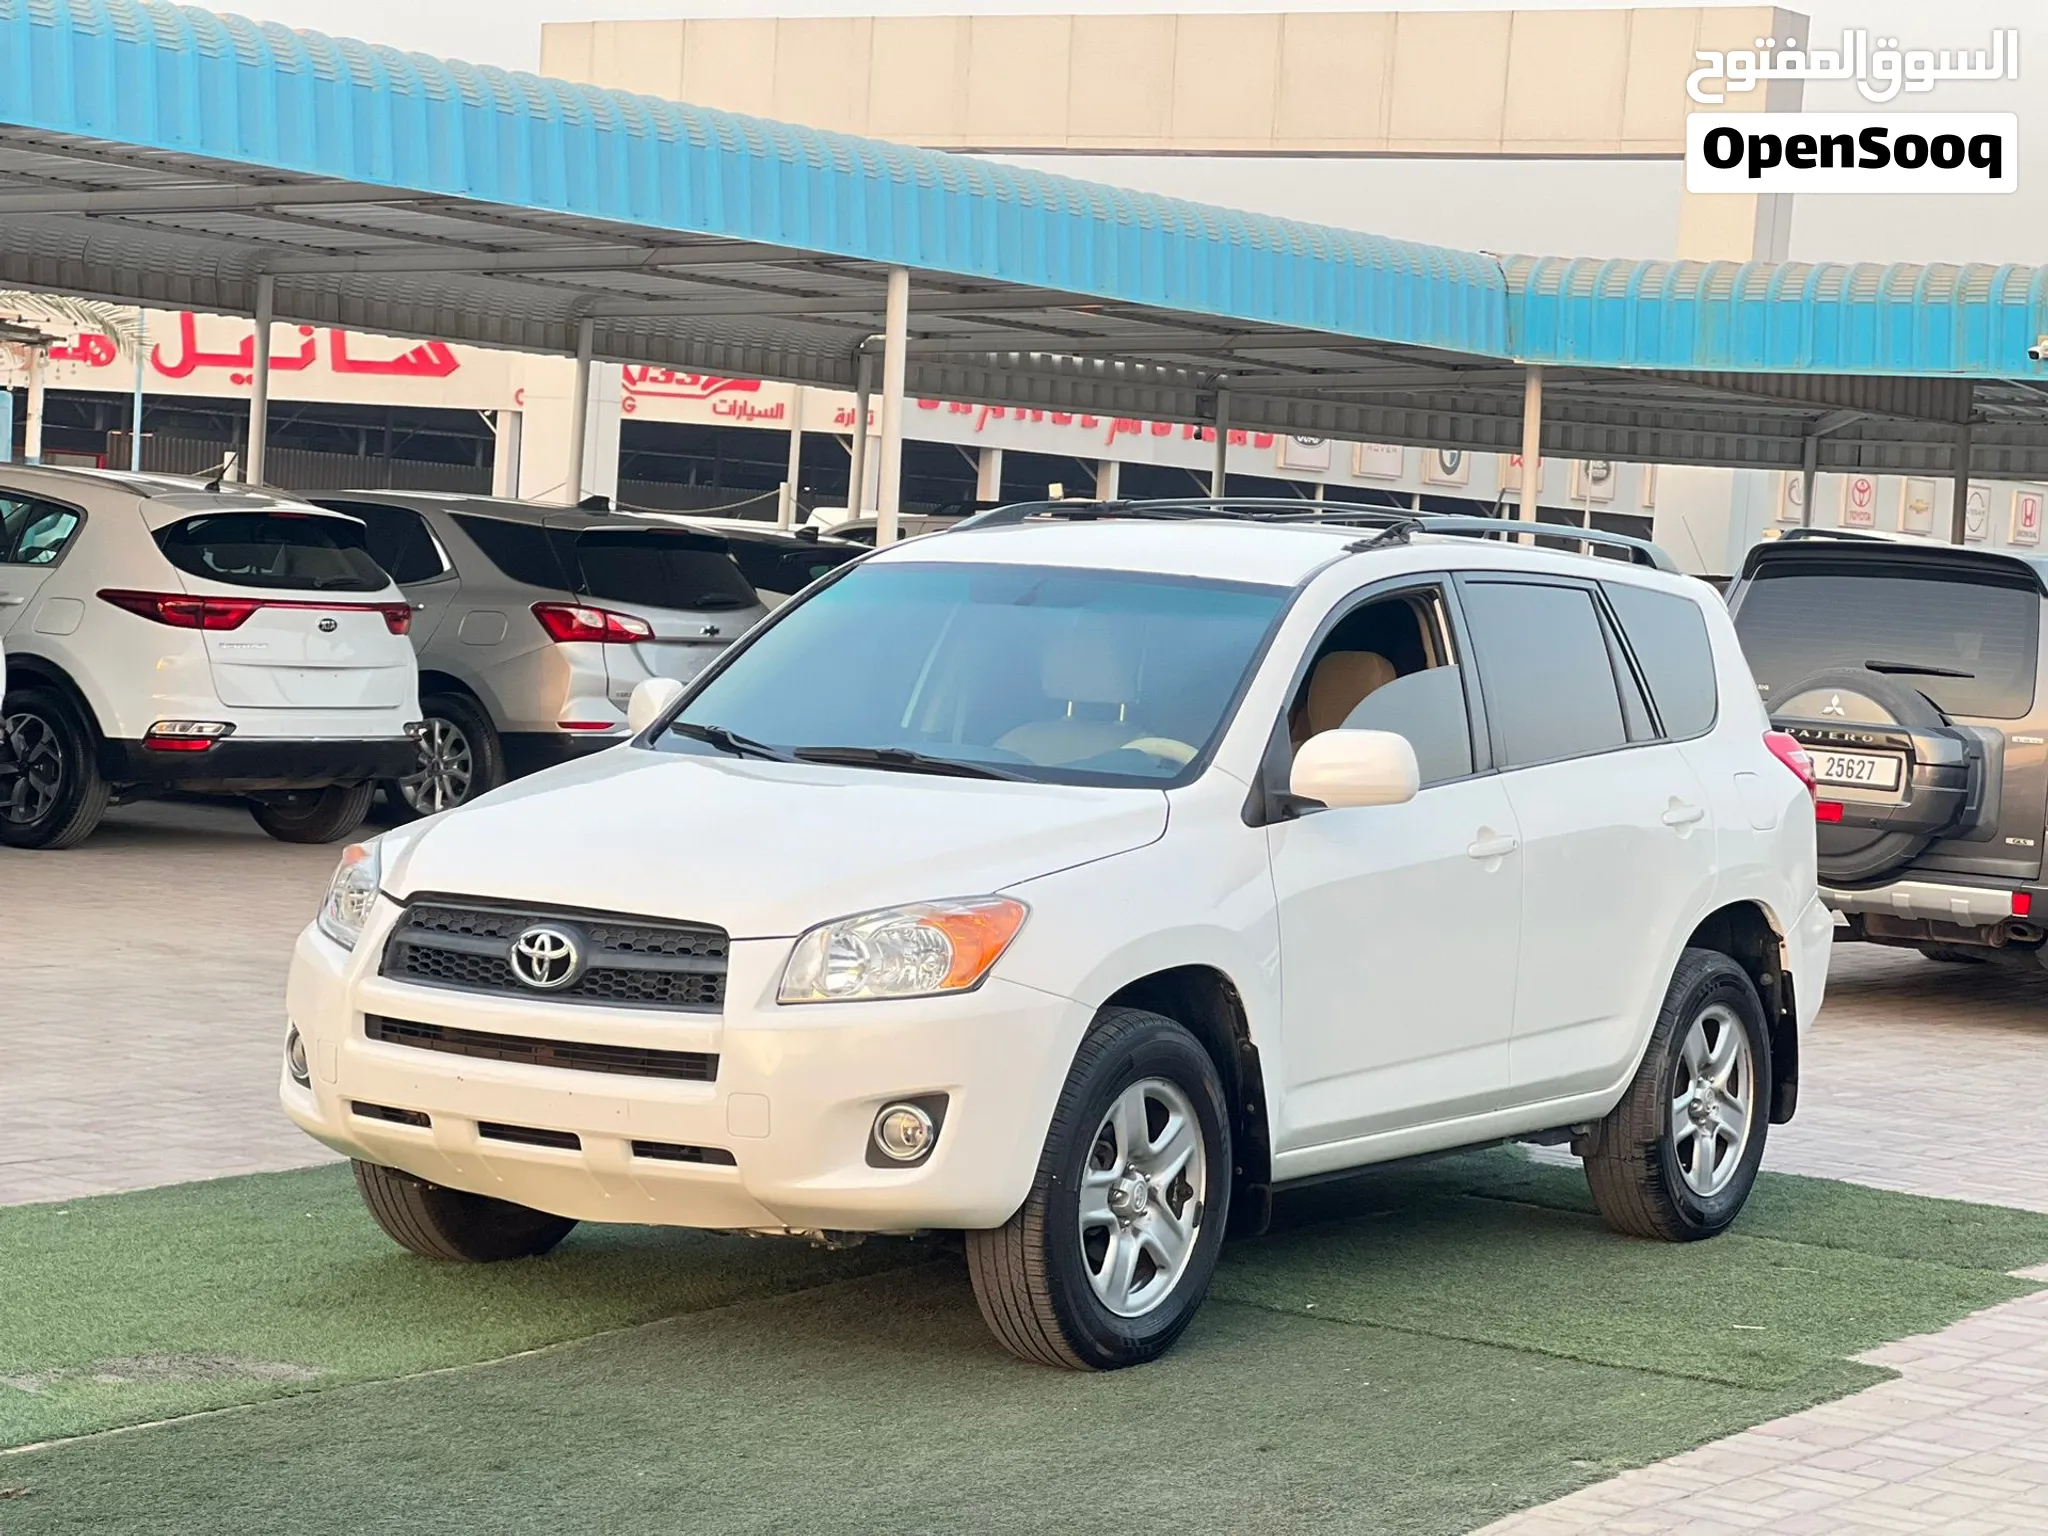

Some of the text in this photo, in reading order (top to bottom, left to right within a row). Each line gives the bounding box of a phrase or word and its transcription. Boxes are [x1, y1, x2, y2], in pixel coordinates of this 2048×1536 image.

[712, 399, 785, 421] السيارات
[1784, 727, 1874, 743] PAJERO
[1825, 757, 1876, 781] 25627
